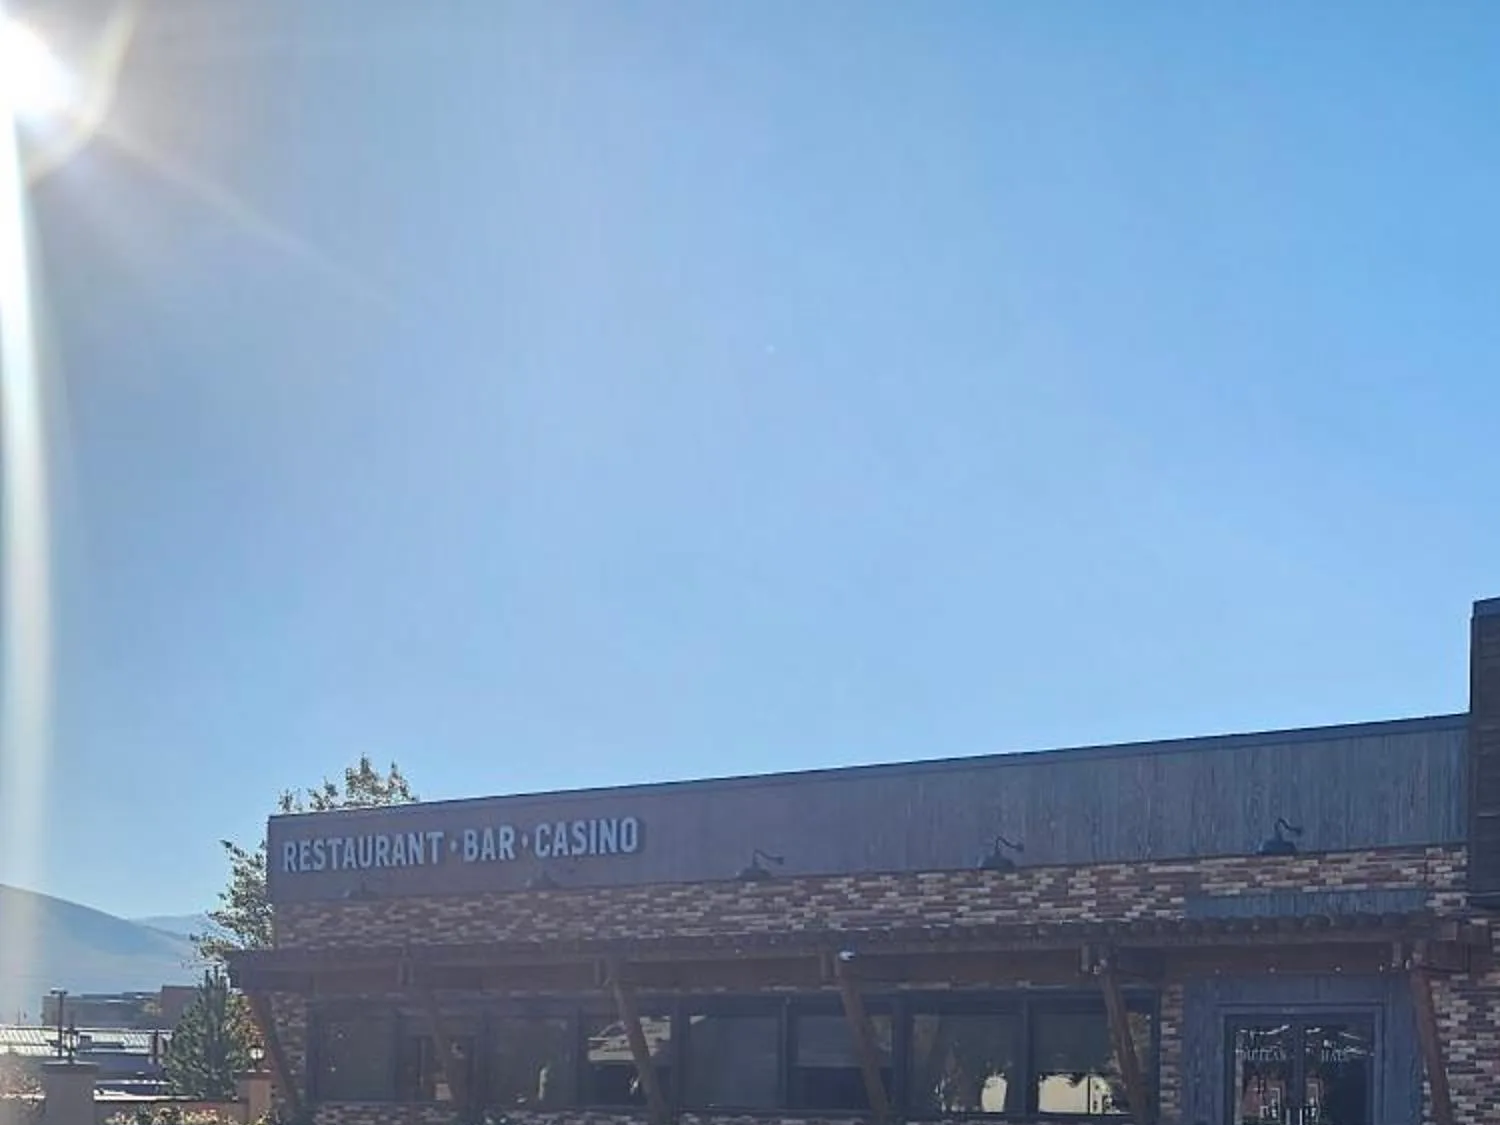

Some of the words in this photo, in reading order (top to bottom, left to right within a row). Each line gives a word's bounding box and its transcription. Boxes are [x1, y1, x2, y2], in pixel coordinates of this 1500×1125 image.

[283, 832, 445, 873] RESTAURANT
[463, 826, 517, 862] BAR
[534, 817, 638, 859] CASINO
